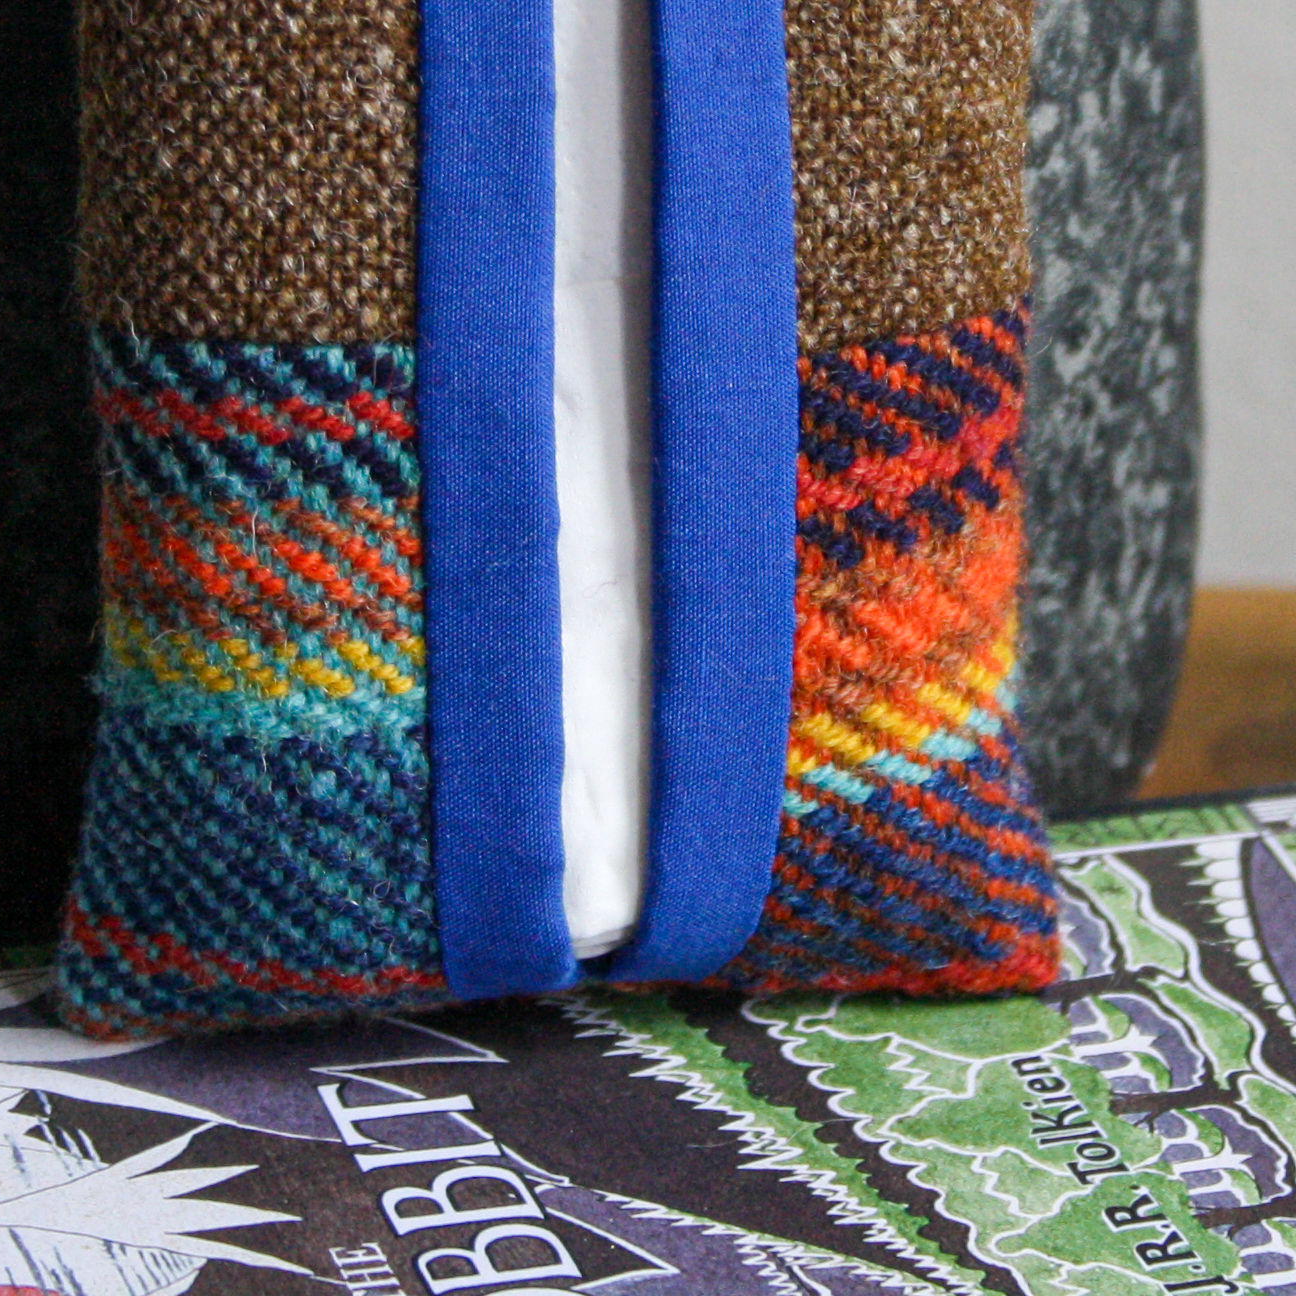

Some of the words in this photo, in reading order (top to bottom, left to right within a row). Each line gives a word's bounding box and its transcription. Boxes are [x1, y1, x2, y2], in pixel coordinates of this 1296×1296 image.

[1010, 1054, 1130, 1185] Tolkien
[315, 1082, 583, 1296] BBIT
[1104, 1184, 1239, 1295] J.R.R.
[329, 1241, 407, 1296] HE
